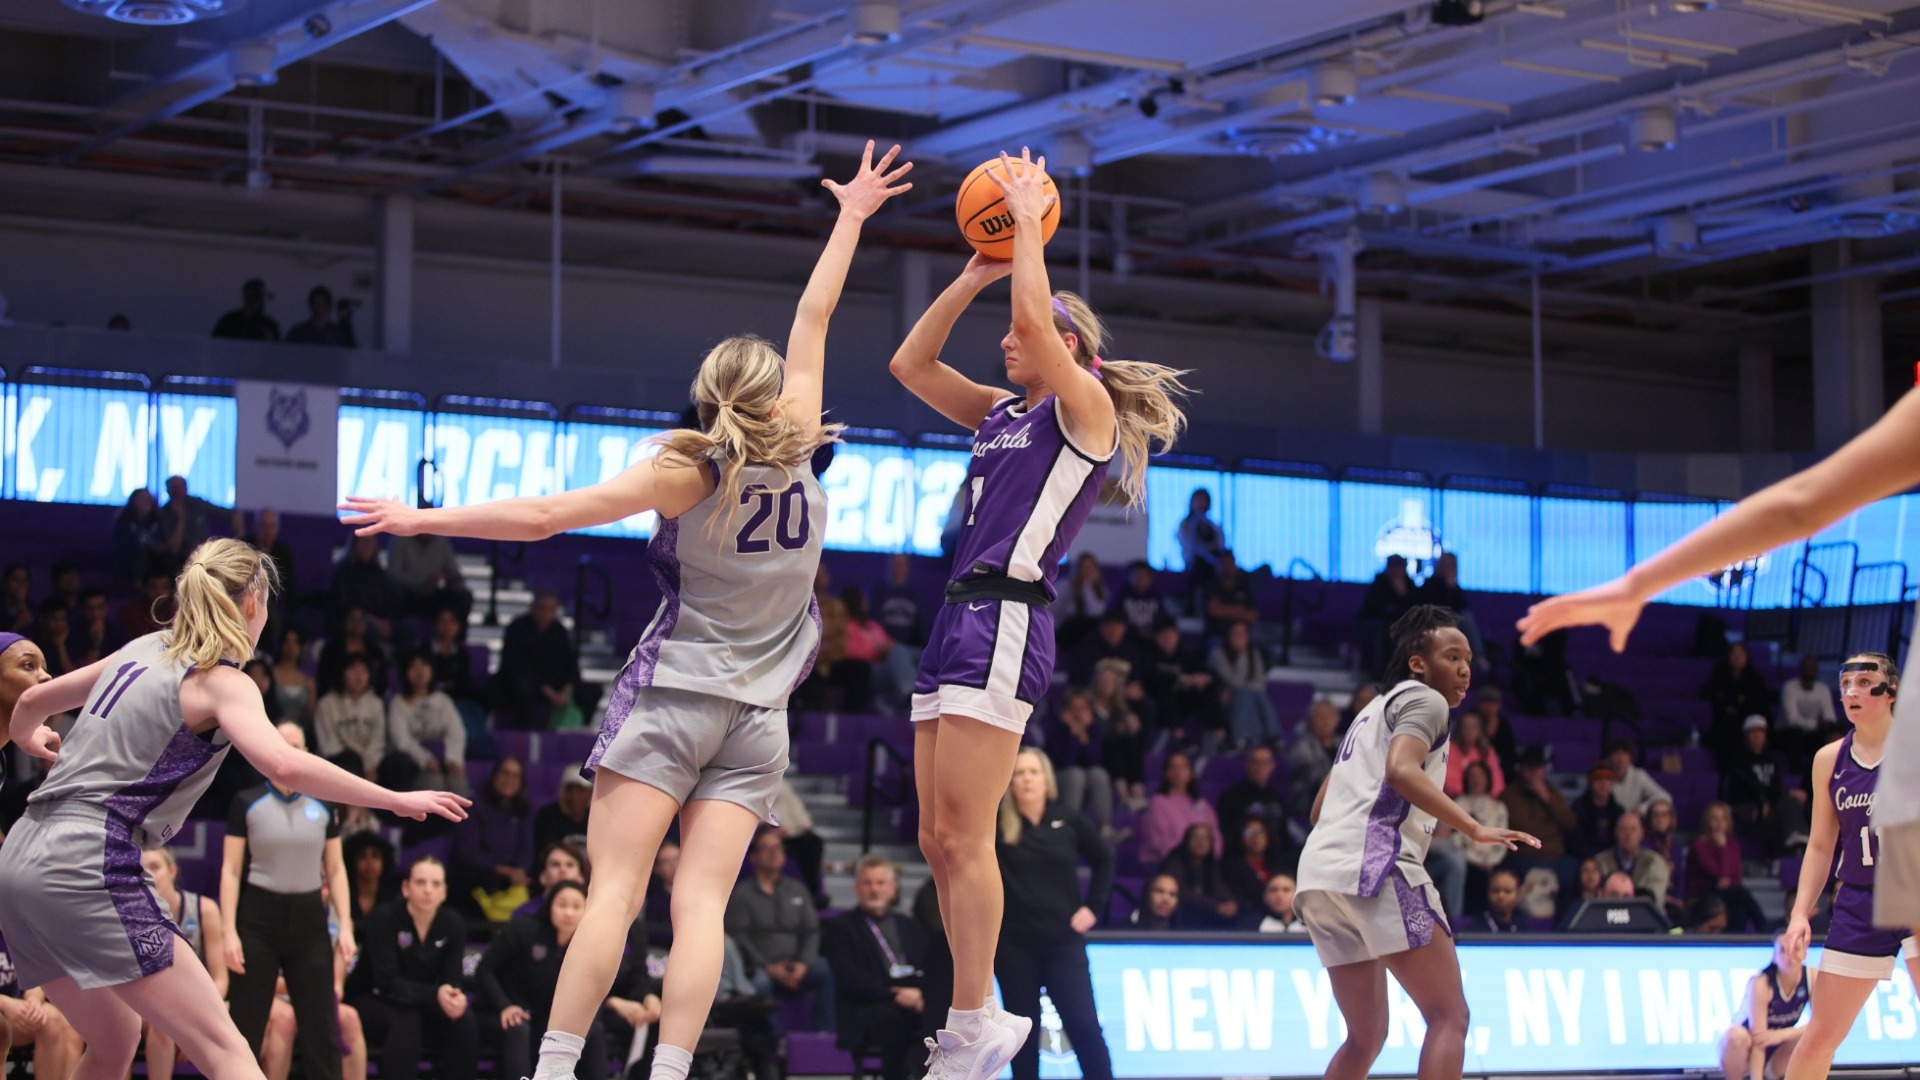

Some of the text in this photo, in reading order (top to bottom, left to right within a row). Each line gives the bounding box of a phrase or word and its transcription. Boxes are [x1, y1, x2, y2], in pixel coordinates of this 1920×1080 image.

[90, 401, 236, 505] NY
[735, 480, 810, 555] 20
[89, 660, 149, 720] 11
[1122, 968, 1275, 1051] NEW
[1504, 968, 1585, 1046] NY
